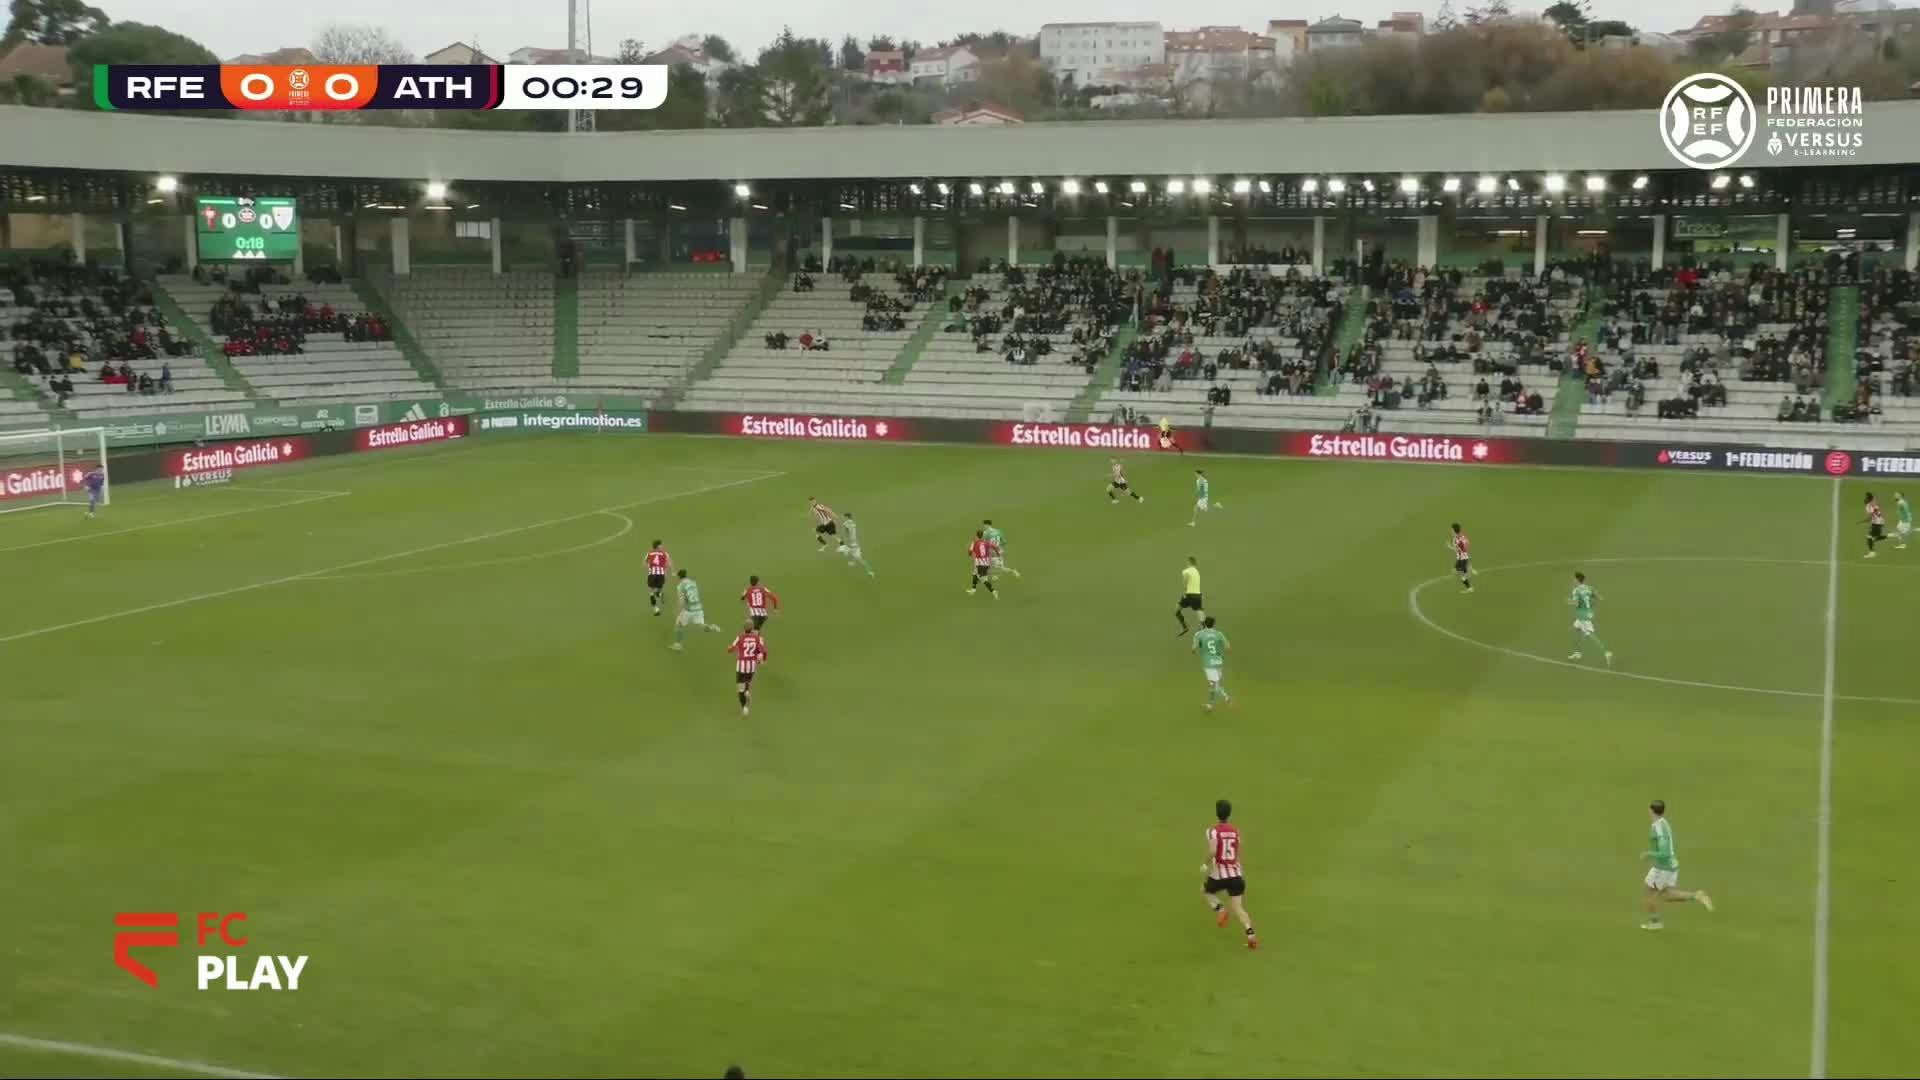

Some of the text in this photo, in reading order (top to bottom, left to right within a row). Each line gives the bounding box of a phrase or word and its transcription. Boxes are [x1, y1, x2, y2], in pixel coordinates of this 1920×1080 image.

[222, 213, 236, 229] 0
[259, 214, 273, 229] 0
[235, 236, 265, 249] 0:18
[205, 413, 250, 436] LEYMA
[523, 412, 643, 429] integralmotion.es
[742, 416, 867, 438] Estrella Galicia
[368, 420, 445, 447] Estrella Galicia
[1012, 424, 1150, 448] Estrella Galicia
[1309, 434, 1463, 459] Estrella Galicia
[182, 442, 278, 472] Estrella Galicia
[1668, 451, 1712, 460] VERSUS
[7, 469, 64, 494] Galicia
[192, 468, 232, 482] VERSUS
[751, 592, 763, 606] 18
[743, 642, 757, 657] 22
[1207, 640, 1216, 654] 5
[1222, 838, 1236, 860] 15
